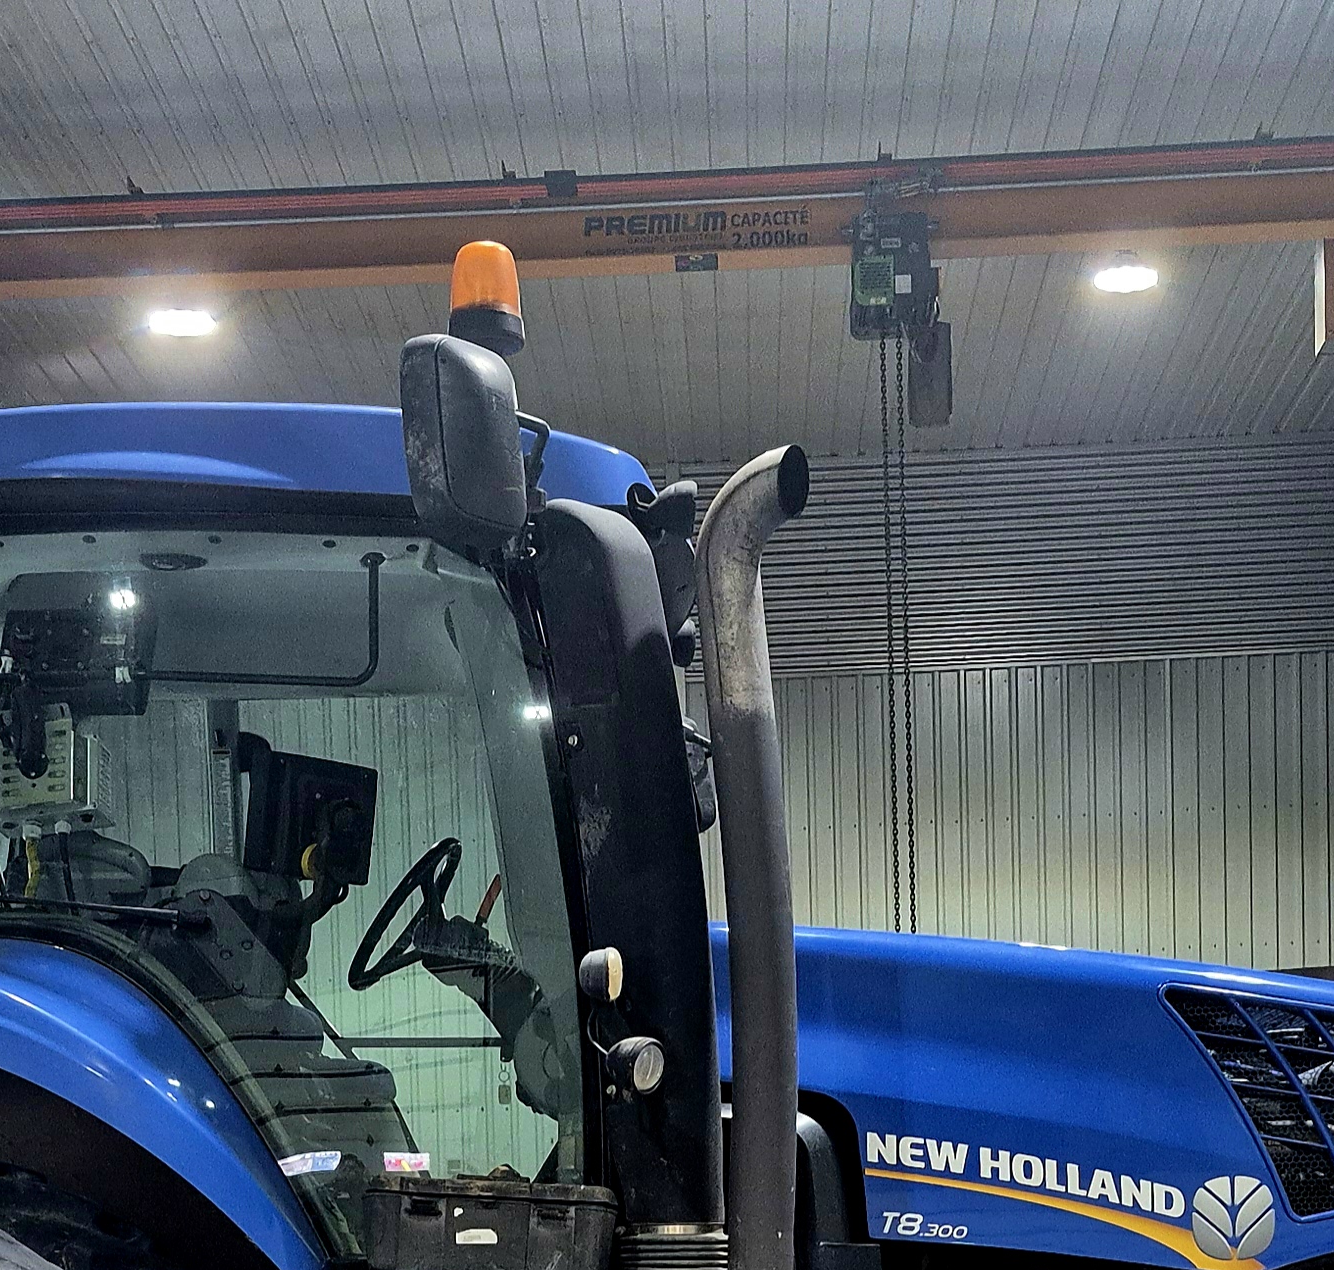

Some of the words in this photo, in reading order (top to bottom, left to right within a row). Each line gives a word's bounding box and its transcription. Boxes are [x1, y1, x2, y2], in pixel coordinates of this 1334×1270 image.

[584, 210, 727, 237] PREMIUM
[730, 205, 810, 228] CAPACITÉ
[866, 1131, 969, 1175] NEW
[978, 1146, 1186, 1219] HOLLAND
